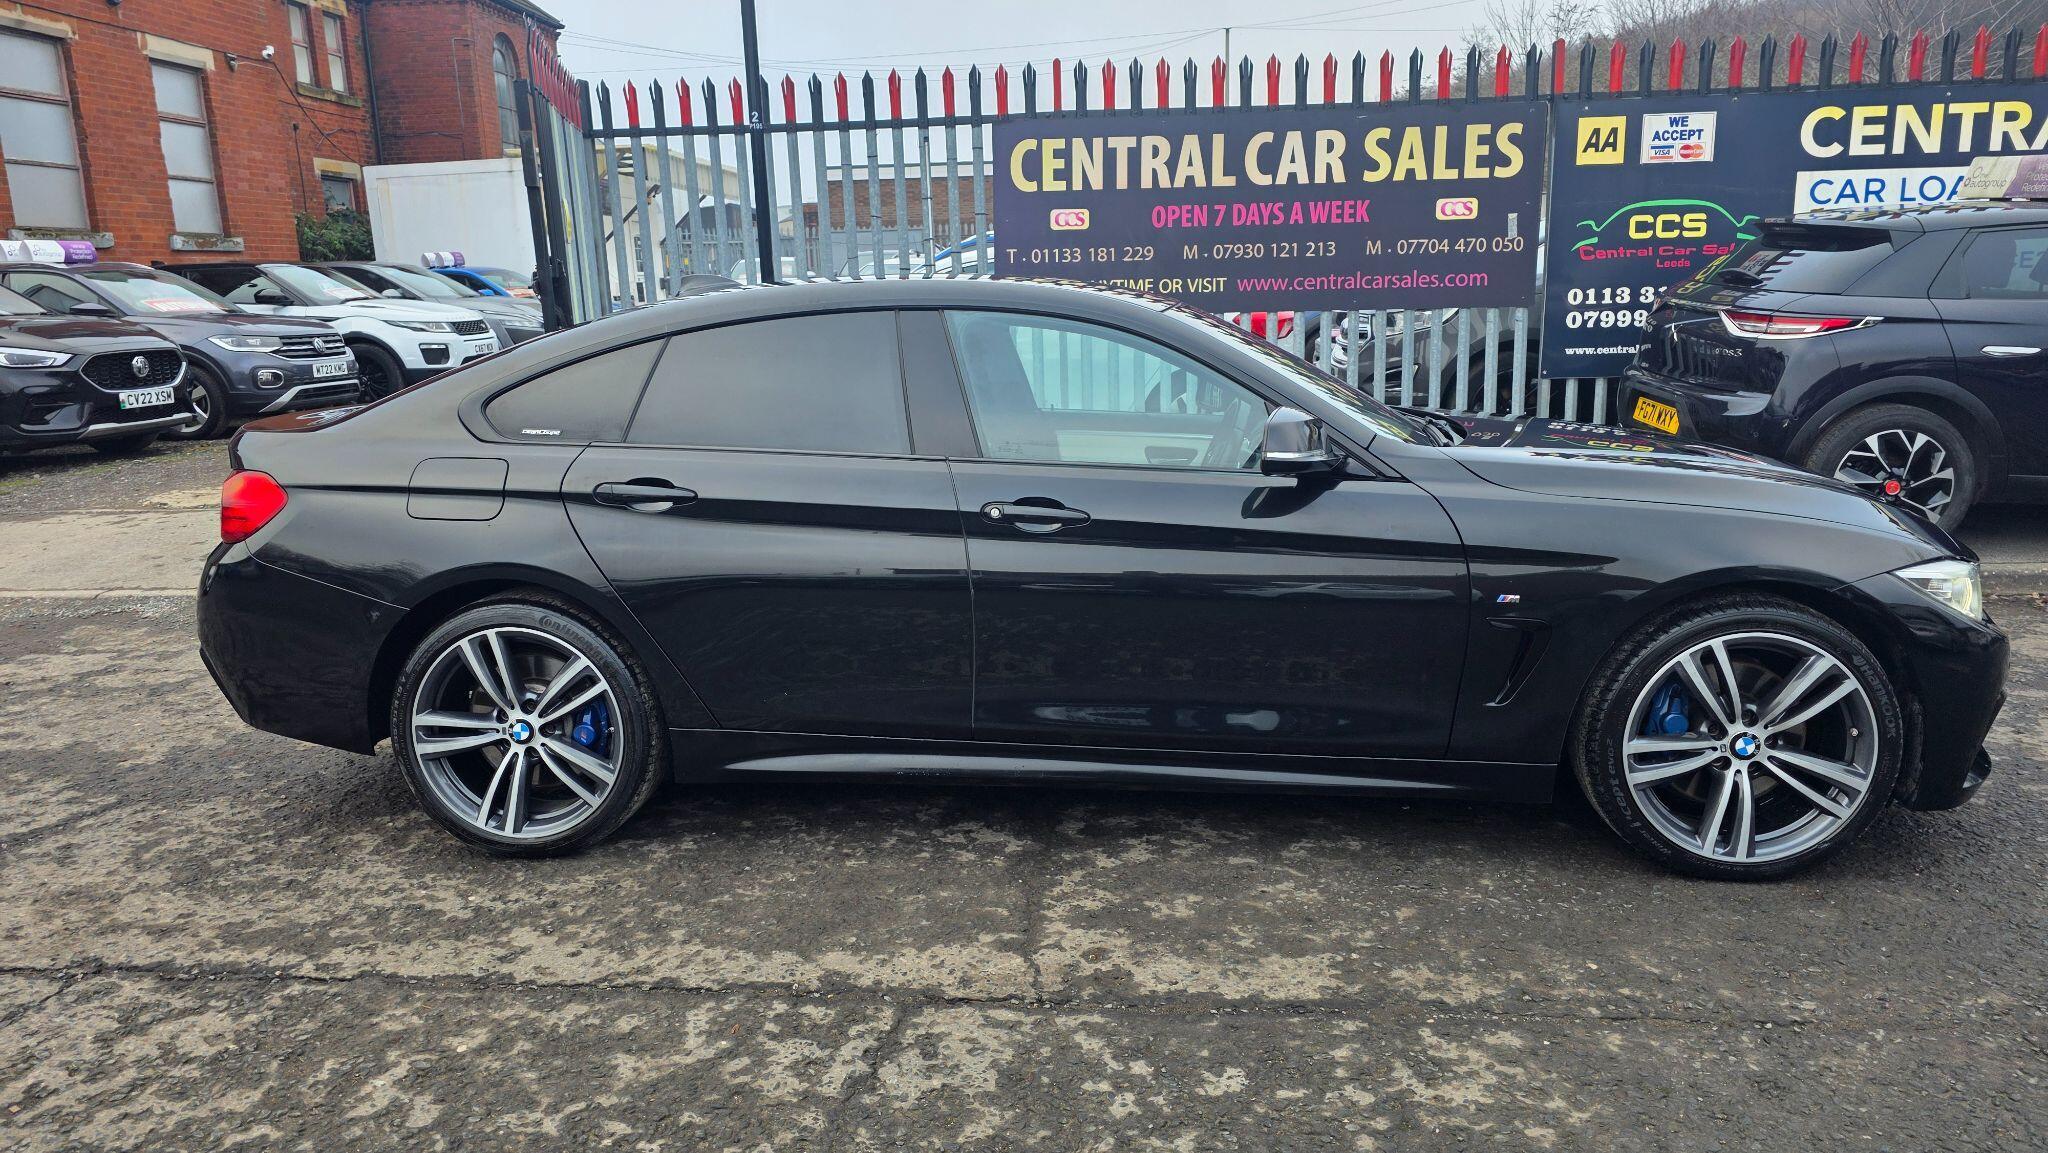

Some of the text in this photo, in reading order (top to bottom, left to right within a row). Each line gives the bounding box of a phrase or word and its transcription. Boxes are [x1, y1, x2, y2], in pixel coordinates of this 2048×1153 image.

[751, 111, 759, 122] 2
[1669, 116, 1689, 127] WE
[1582, 127, 1619, 153] AA
[1652, 129, 1704, 141] ACCEPT
[1010, 122, 1524, 192] CENTRAL CAR SALES
[1809, 178, 1886, 204] CAR
[1152, 200, 1370, 228] OPEN 7 DAYS A WEEK
[1440, 201, 1473, 217] CCS
[1054, 211, 1086, 227] CCS
[1629, 213, 1707, 240] CCS
[1031, 248, 1082, 263] 01133
[1088, 248, 1116, 263] 181
[1123, 246, 1154, 262] 229
[1213, 243, 1264, 259] 07930
[1271, 243, 1298, 258] 121
[1305, 241, 1336, 257] 213
[1397, 239, 1449, 255] 07704
[1455, 238, 1487, 253] 470
[1492, 236, 1524, 252] 050
[1579, 246, 1653, 261] Central
[1658, 246, 1696, 256] Car
[1656, 259, 1691, 268] Leeds
[1158, 279, 1182, 294] OR
[1187, 278, 1227, 293] VISIT
[1237, 270, 1488, 291] www.centralcarsales.com
[1567, 287, 1631, 305] 0113
[1566, 310, 1648, 328] 07999
[127, 388, 172, 406] CV22 XSM
[1638, 401, 1657, 421] FG71
